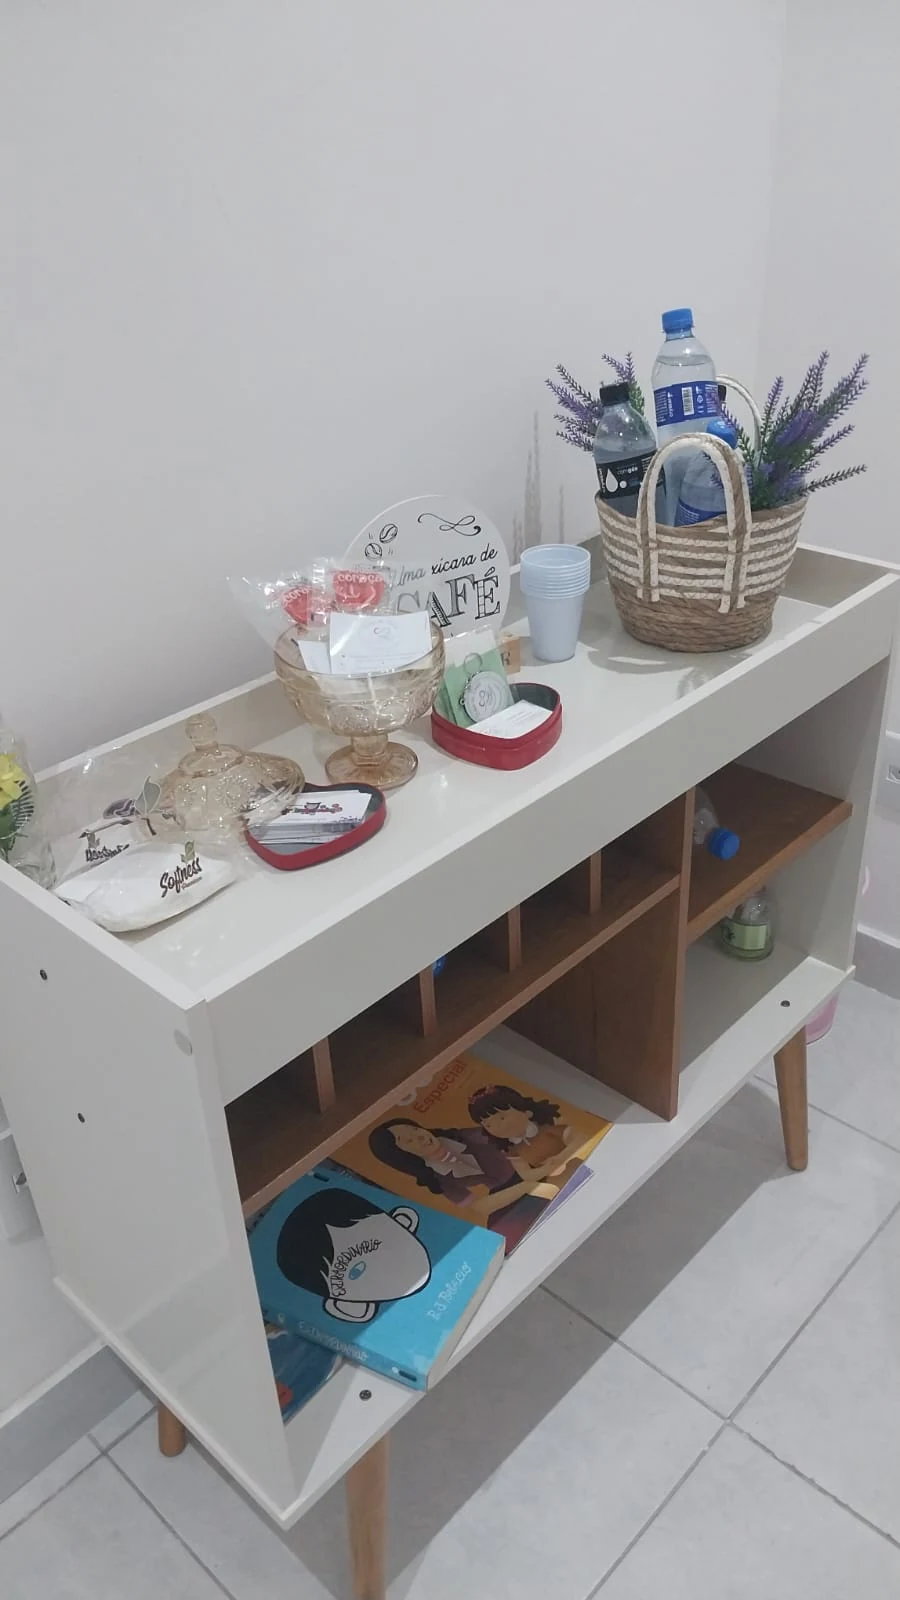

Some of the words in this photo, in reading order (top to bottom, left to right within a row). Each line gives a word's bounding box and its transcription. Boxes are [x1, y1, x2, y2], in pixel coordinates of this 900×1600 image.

[480, 543, 498, 561] de
[397, 566, 501, 628] CAFÉ
[160, 857, 203, 898] Softness
[412, 1058, 468, 1114] Especial
